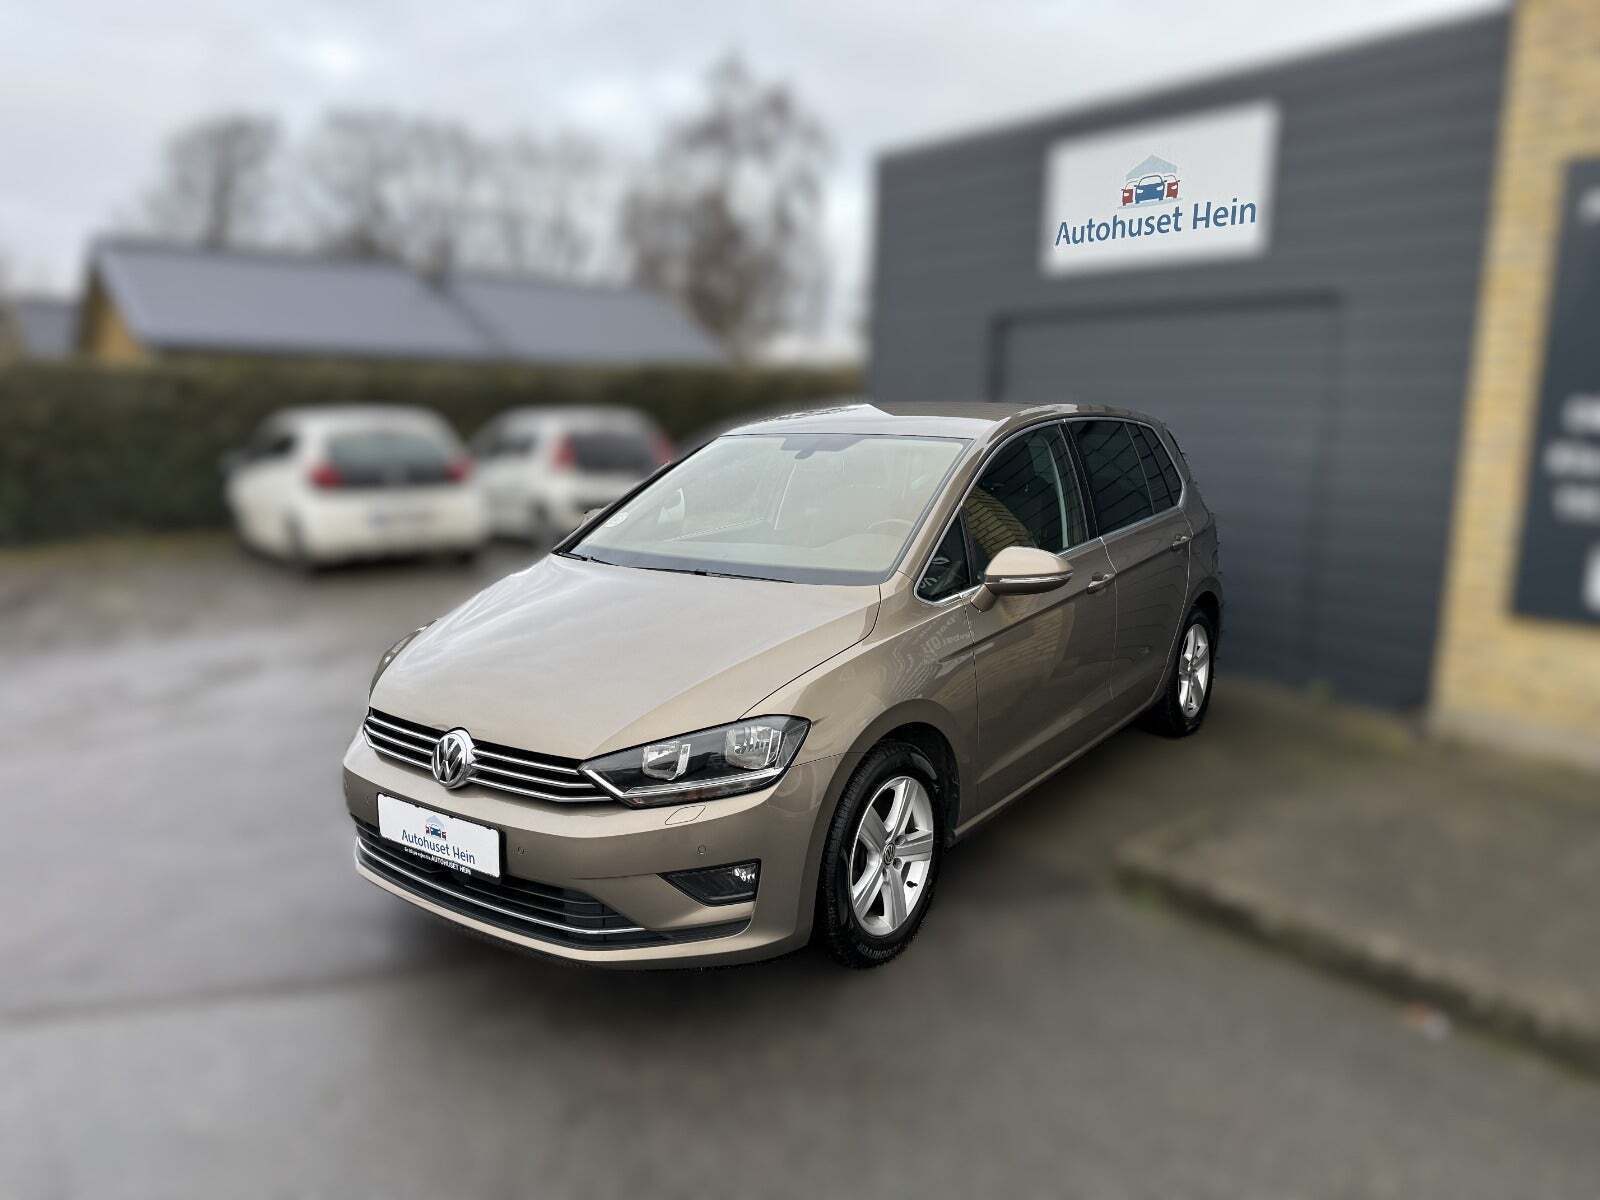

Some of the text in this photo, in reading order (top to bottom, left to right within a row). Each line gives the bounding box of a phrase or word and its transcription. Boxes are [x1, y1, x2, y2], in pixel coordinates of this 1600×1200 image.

[1055, 198, 1256, 246] Autohuset Hein
[401, 829, 450, 856] Autohuset
[453, 846, 476, 864] Hein
